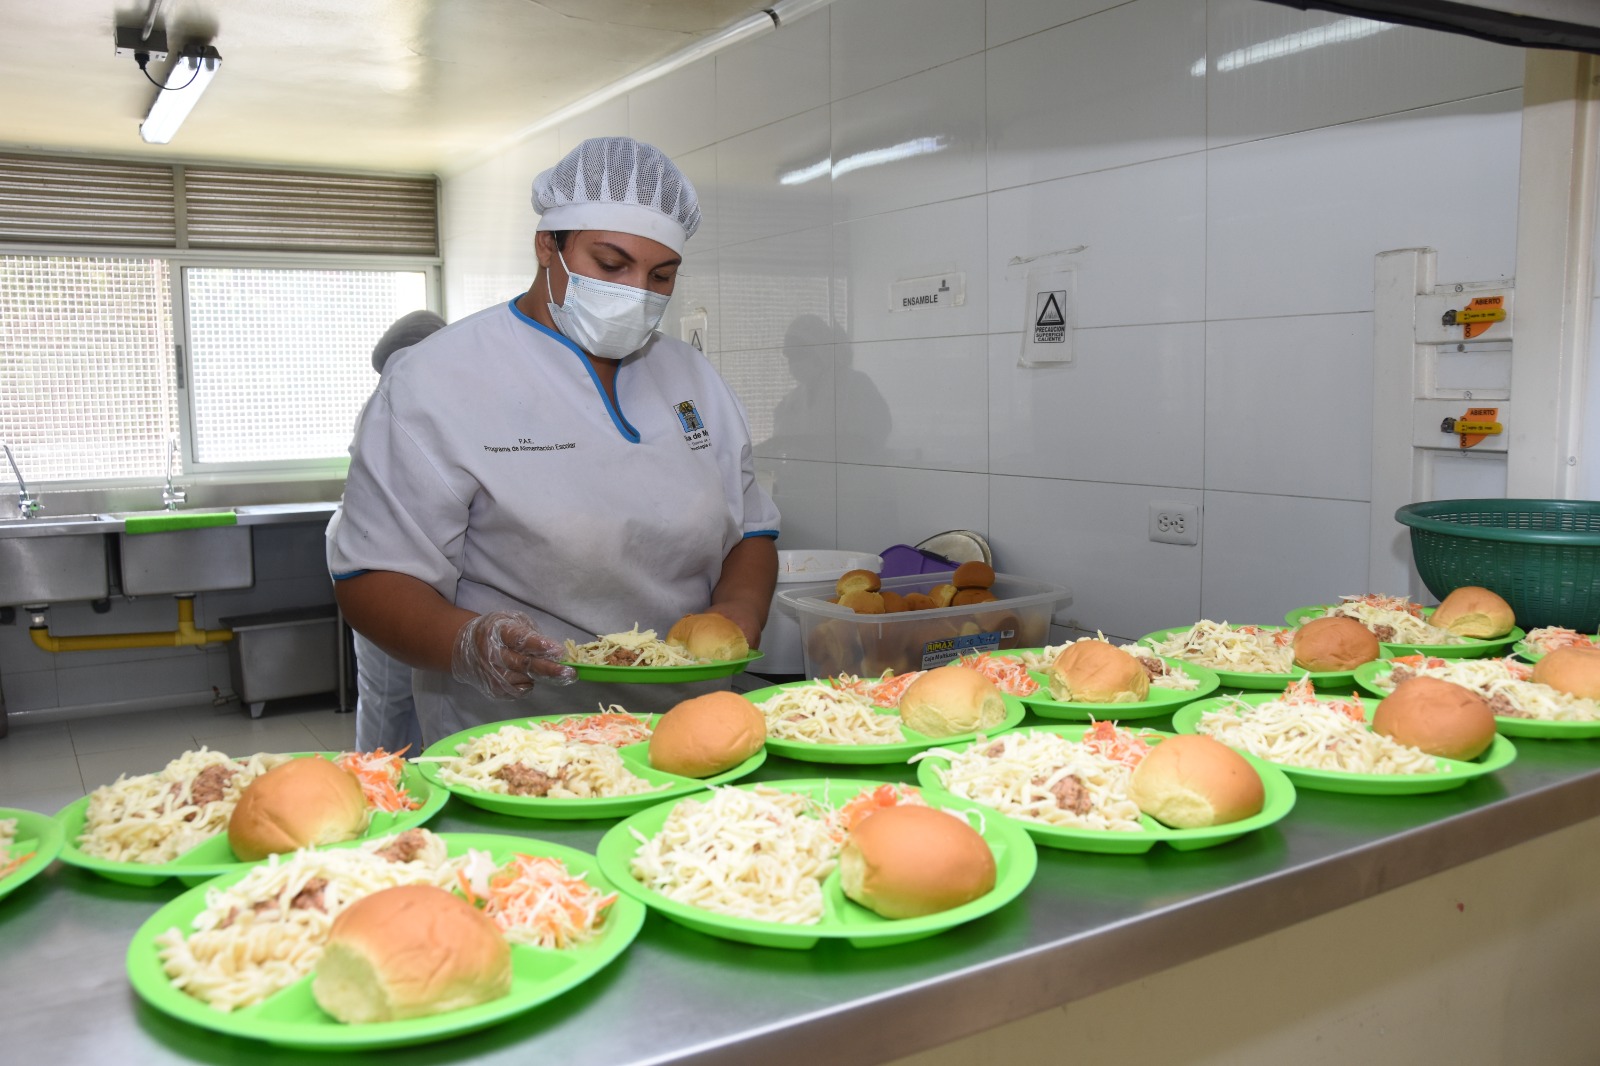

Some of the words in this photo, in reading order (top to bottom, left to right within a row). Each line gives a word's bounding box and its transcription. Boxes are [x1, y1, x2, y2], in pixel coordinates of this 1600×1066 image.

[903, 294, 938, 307] ENSAMBLE
[483, 445, 511, 453] Programa
[555, 442, 576, 451] Escolar
[927, 641, 953, 652] RIMAX
